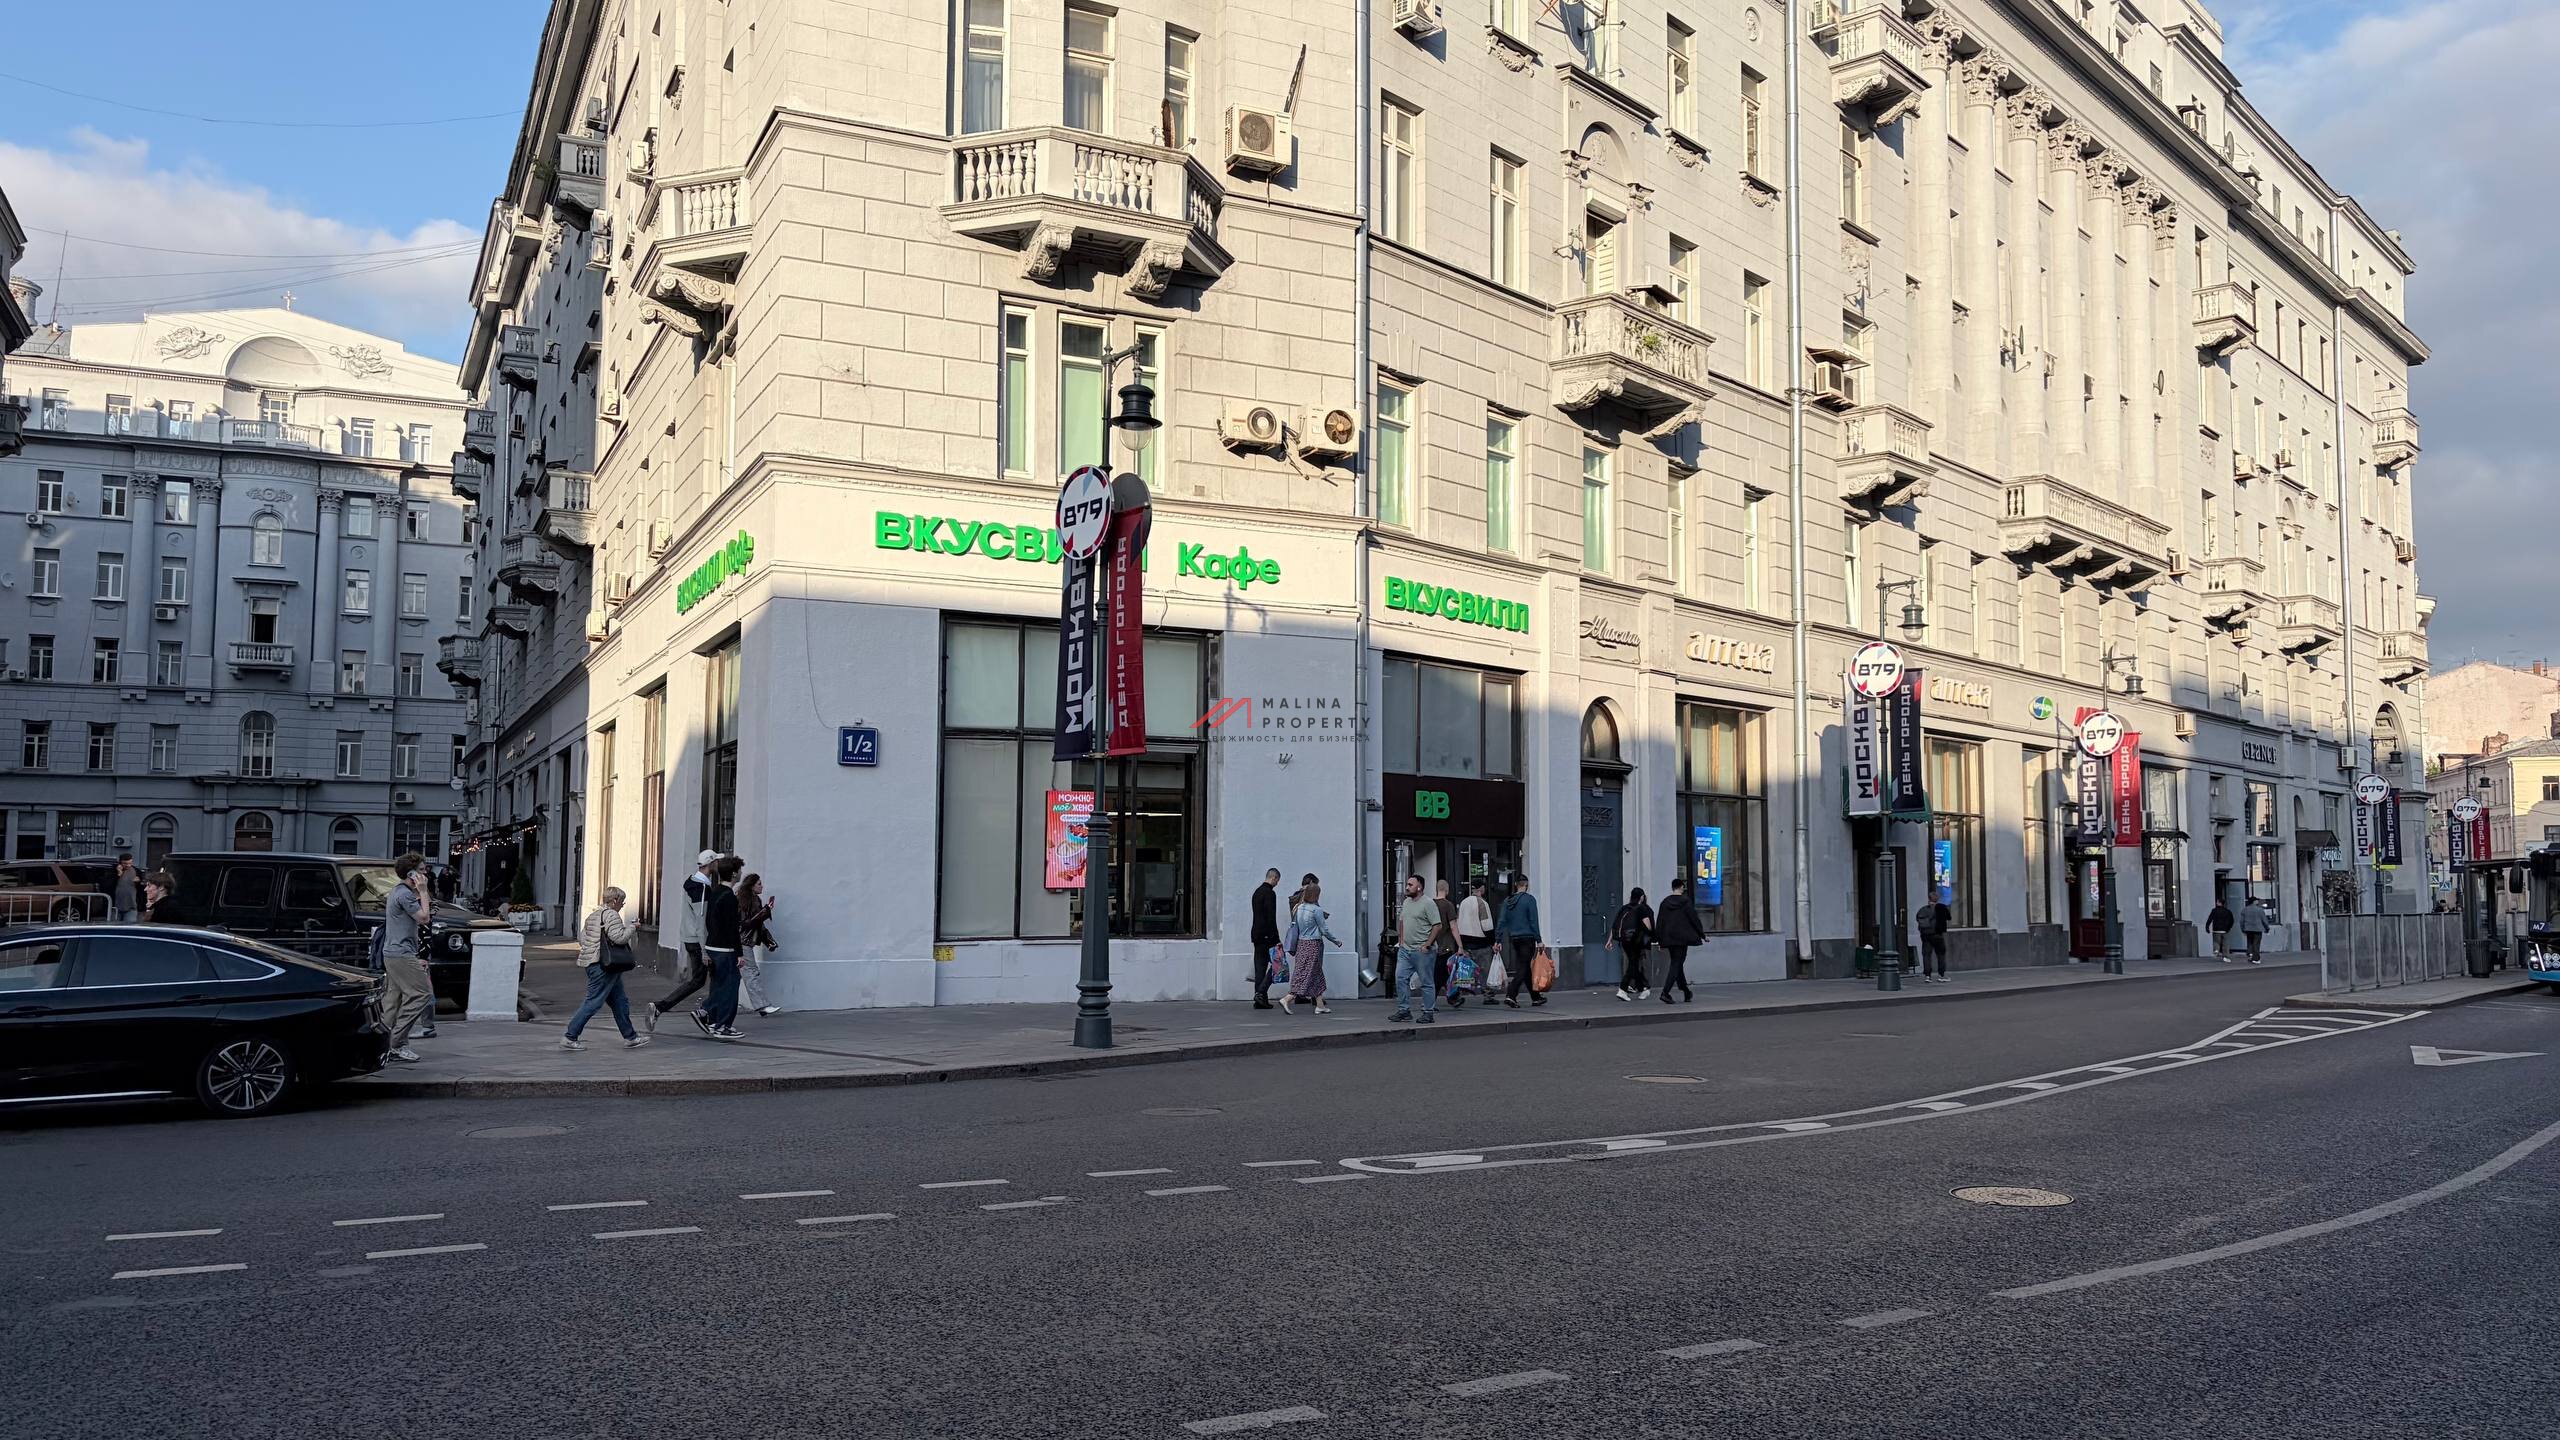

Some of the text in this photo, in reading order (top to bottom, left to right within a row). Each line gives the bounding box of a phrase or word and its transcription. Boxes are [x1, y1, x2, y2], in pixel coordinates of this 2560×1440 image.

[1063, 497, 1103, 528] 879
[875, 510, 1281, 590] ВКУСВ Кафе
[1384, 575, 1529, 635] ВКУСВИЛЛ
[1116, 536, 1128, 728] ДЕНЬ ГОРОДА
[1579, 615, 1641, 647] Mascara
[1686, 630, 1776, 675] аптека
[1858, 663, 1896, 676] 879
[1930, 676, 1992, 709] аптека
[845, 734, 873, 754] 1/2
[1901, 684, 1913, 795] ДЕНЬ ГОРОДА
[2086, 727, 2117, 740] 879
[2121, 745, 2131, 835] ДЕНЬ ГОРОДА
[2360, 785, 2385, 793] 879
